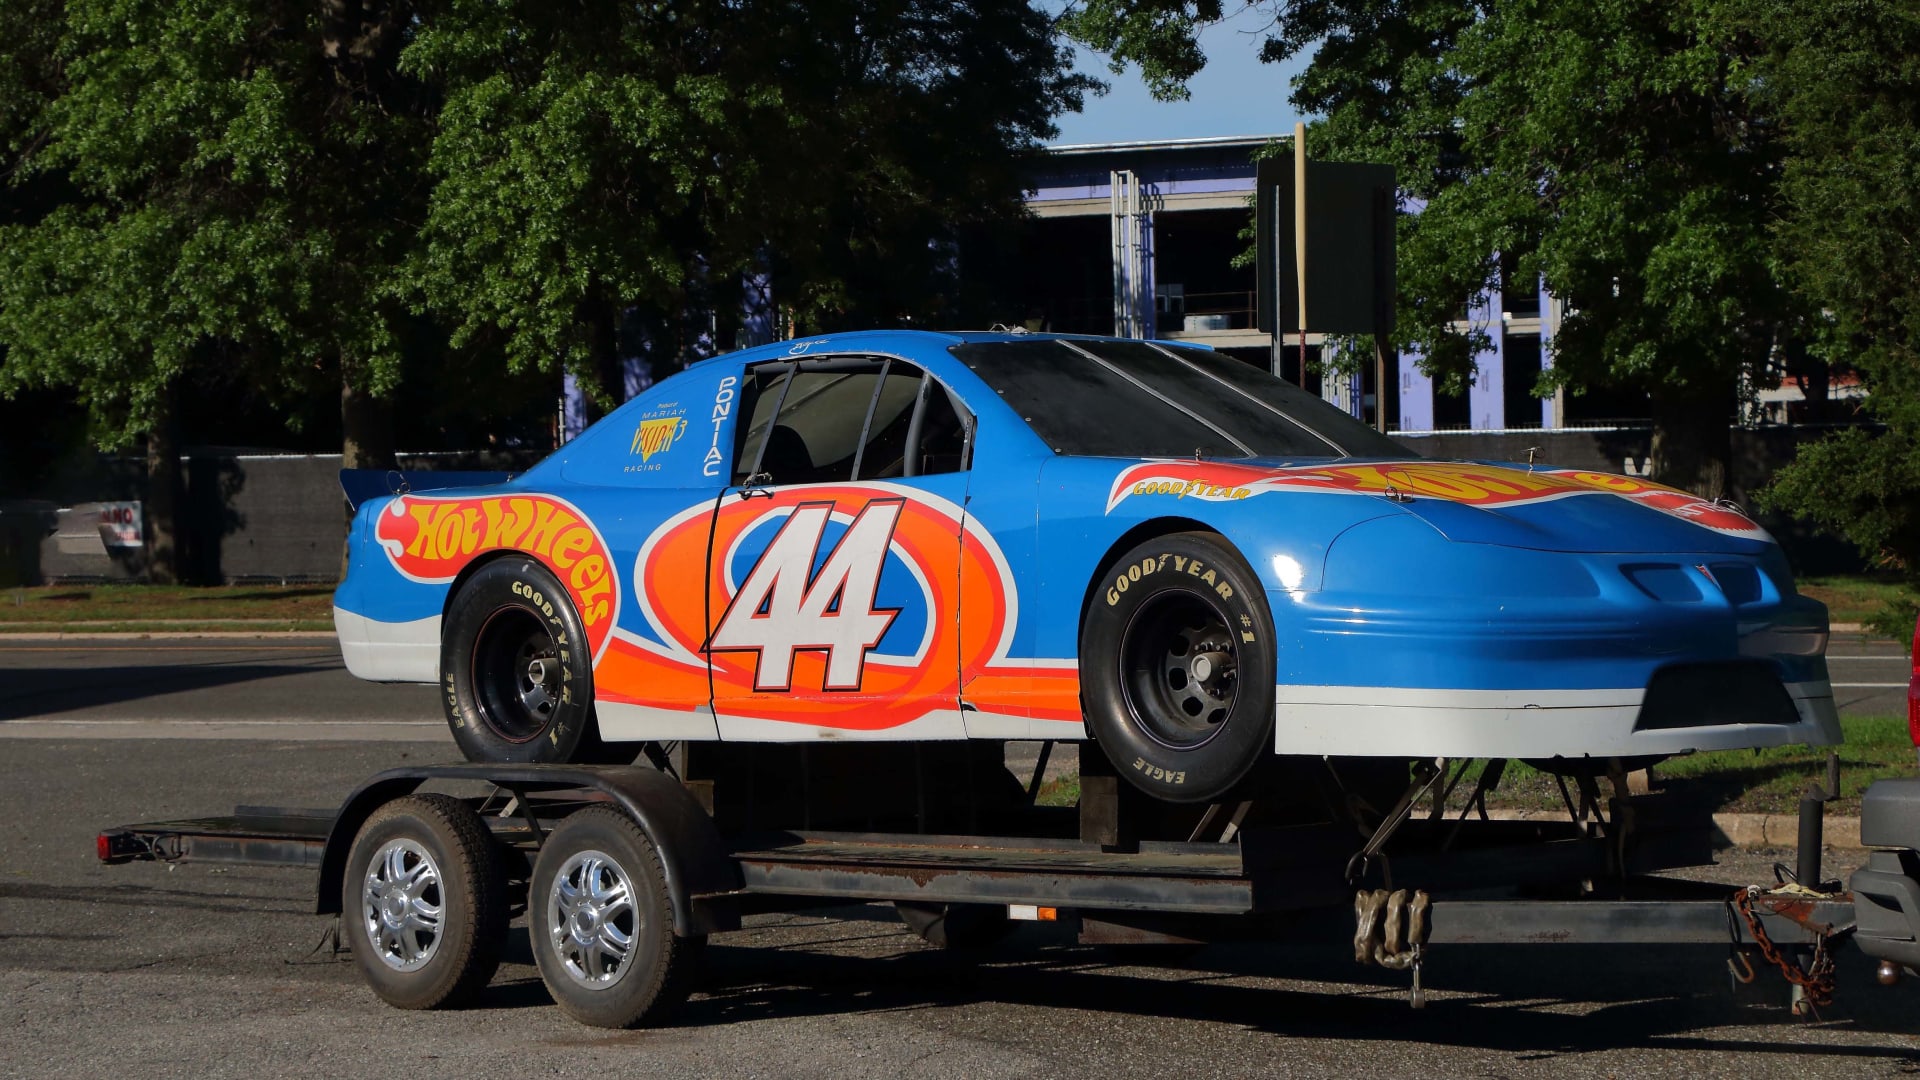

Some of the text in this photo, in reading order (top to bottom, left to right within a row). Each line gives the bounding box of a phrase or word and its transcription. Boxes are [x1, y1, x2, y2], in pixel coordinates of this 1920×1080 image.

[642, 408, 687, 419] MARIAH
[703, 376, 736, 477] PONTIAC
[624, 463, 661, 473] RACING
[406, 503, 482, 560] Hot
[698, 497, 908, 692] 44
[1133, 757, 1186, 784] EAGLE
